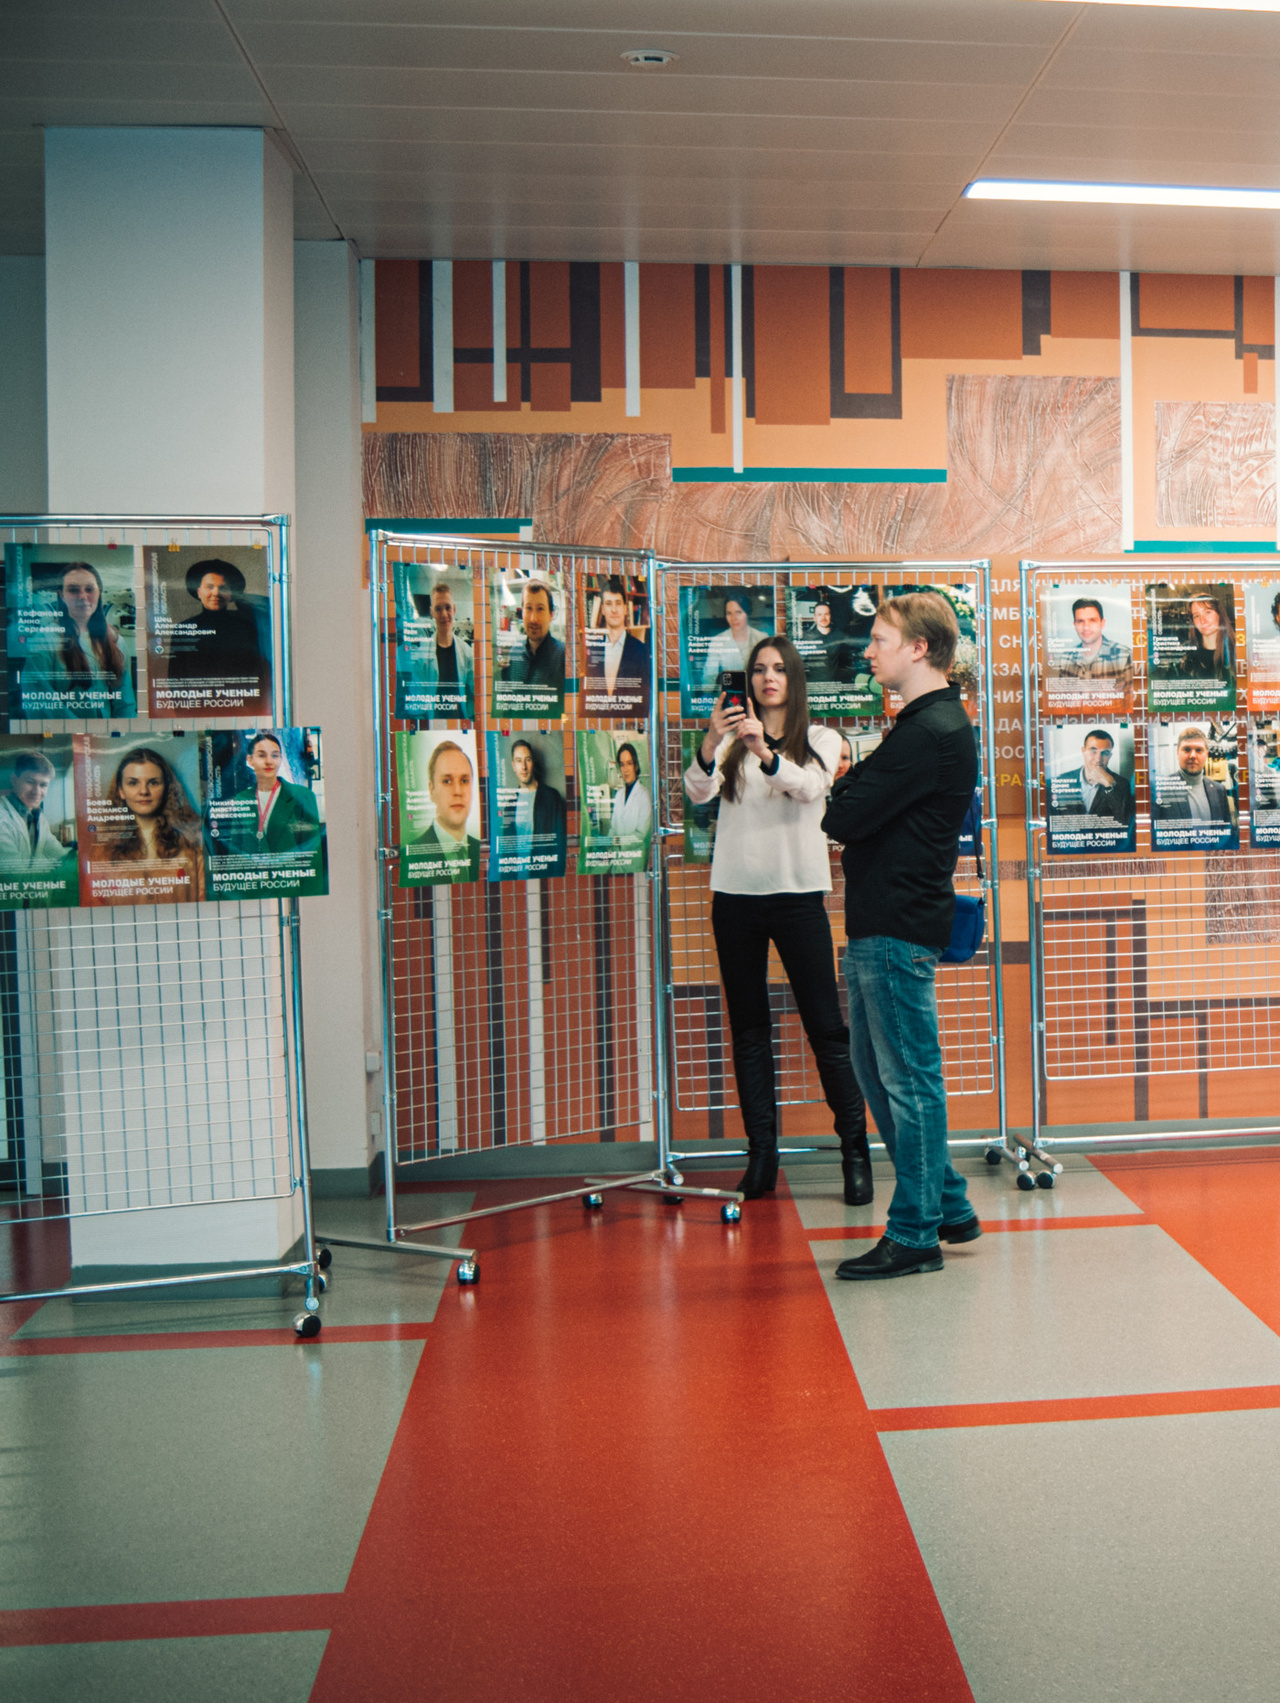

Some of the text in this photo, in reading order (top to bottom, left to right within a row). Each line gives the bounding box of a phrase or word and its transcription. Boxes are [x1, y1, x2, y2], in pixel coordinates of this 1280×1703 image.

[990, 579, 1022, 595] ДЛЯ
[22, 692, 75, 701] МОЛОДЫЕ
[157, 689, 260, 699] МОЛОДЫЕ УЧЕНЫЕ
[496, 694, 530, 702] МОЛОДЫЕ
[1049, 692, 1089, 700] МОЛОДЫЕ
[204, 699, 243, 707] РОССИИ
[586, 695, 642, 703] МОЛОДЫЕ УЧЕНЫЕ
[1153, 699, 1185, 707] БУДУЩЕЕ
[405, 703, 432, 711] БУДУЩЕЕ
[87, 814, 135, 822] Андреевна
[1052, 831, 1127, 840] МОЛОДЫЕ УЧЕНЫЕ
[1156, 830, 1196, 838] МОЛОДЫЕ
[586, 850, 642, 859] МОЛОДЫЕ УЧЕНЫЕ
[409, 859, 471, 870] МОЛОДЫЕ УЧЕНЫЕ
[499, 855, 558, 865] МОЛОДЫЕ УЧЕНЫЕ
[213, 870, 316, 881] МОЛОДЫЕ УЧЕНЫЕ
[408, 868, 460, 879] БУДУЩЕЕ РОССИИ
[23, 881, 66, 890] УЧЕНЫЕ
[92, 876, 190, 888] МОЛОДЫЕ УЧЕНЫЕ
[213, 880, 300, 891] БУДУЩЕЕ РОССИИ
[92, 887, 173, 897] БУДУЩЕЕ РОССИИ
